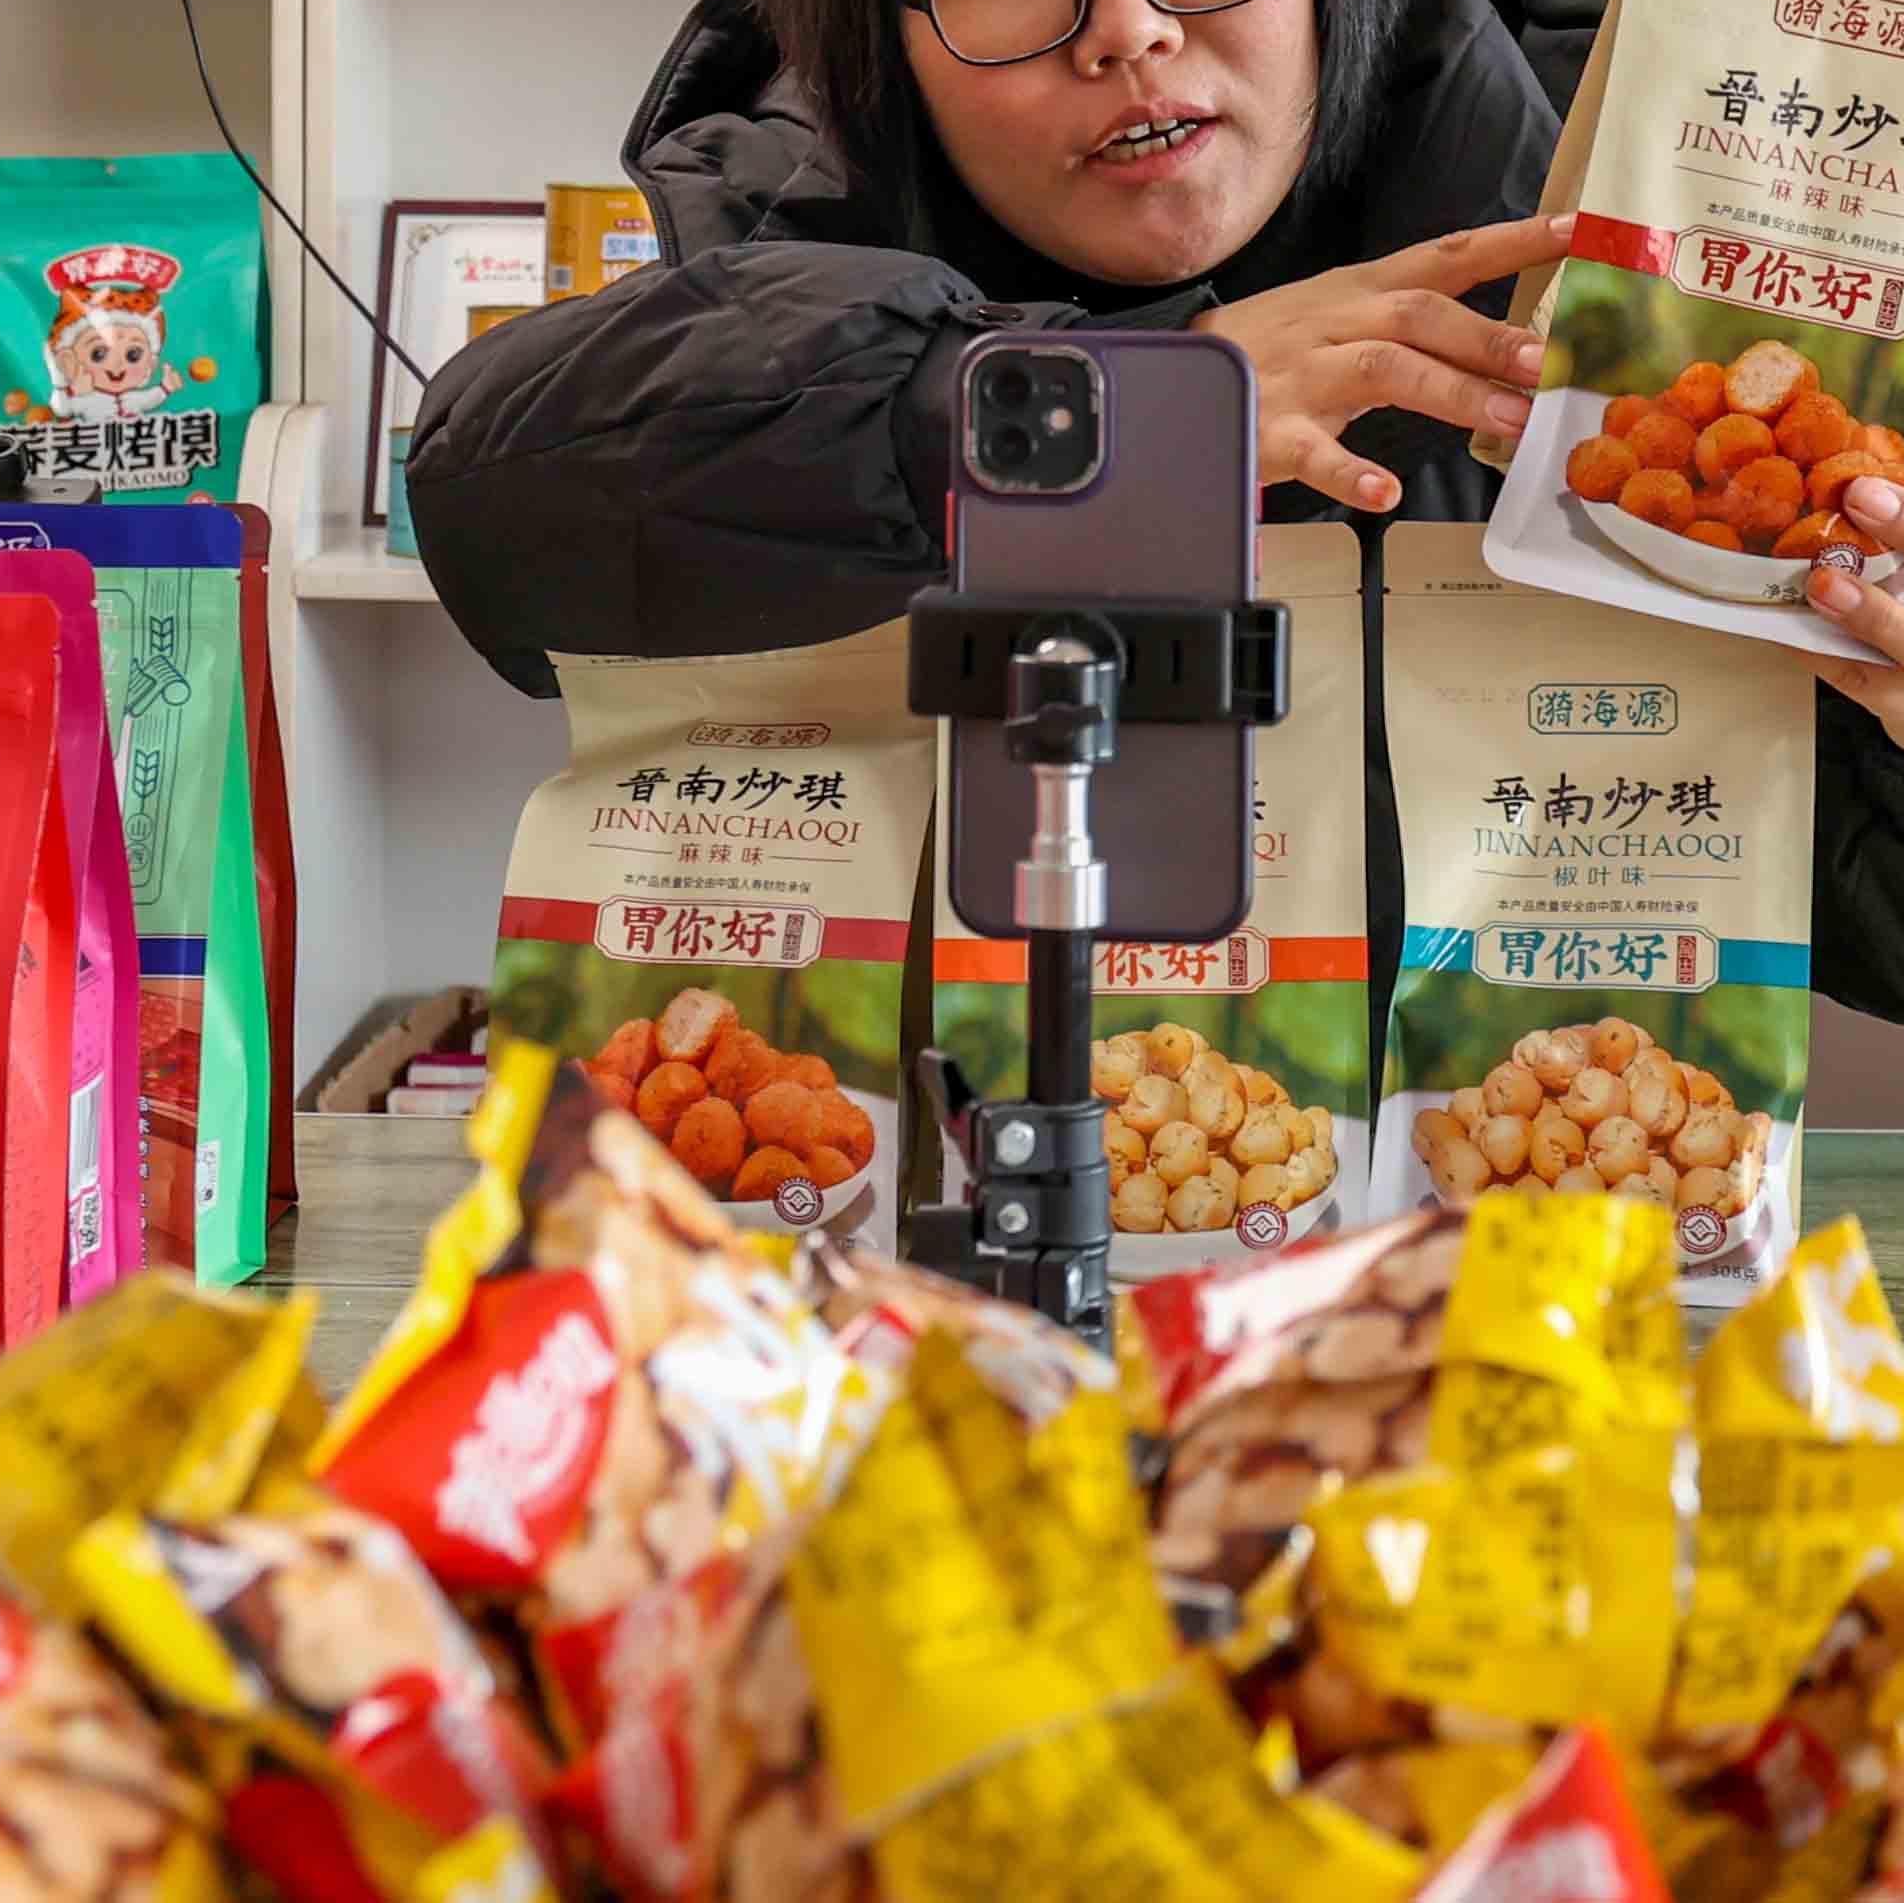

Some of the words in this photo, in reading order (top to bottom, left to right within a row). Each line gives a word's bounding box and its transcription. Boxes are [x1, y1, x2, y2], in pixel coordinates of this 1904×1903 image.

[1769, 179, 1865, 219] 麻辣味
[1699, 238, 1874, 320] 胃你好
[117, 470, 187, 490] KAOMO
[1536, 691, 1664, 730] 漪海源
[616, 764, 848, 813] 晋南炒琪
[1483, 773, 1722, 830] 晋南炒琪
[590, 807, 862, 846] JINNANCHAOQI
[1473, 827, 1744, 860] JINNANCHAOQI
[679, 844, 764, 864] 麻辣味
[1554, 865, 1645, 886] 椒叶味
[621, 905, 777, 960] 胃你好
[1096, 943, 1219, 986] 你好
[1499, 932, 1668, 982] 胃你好
